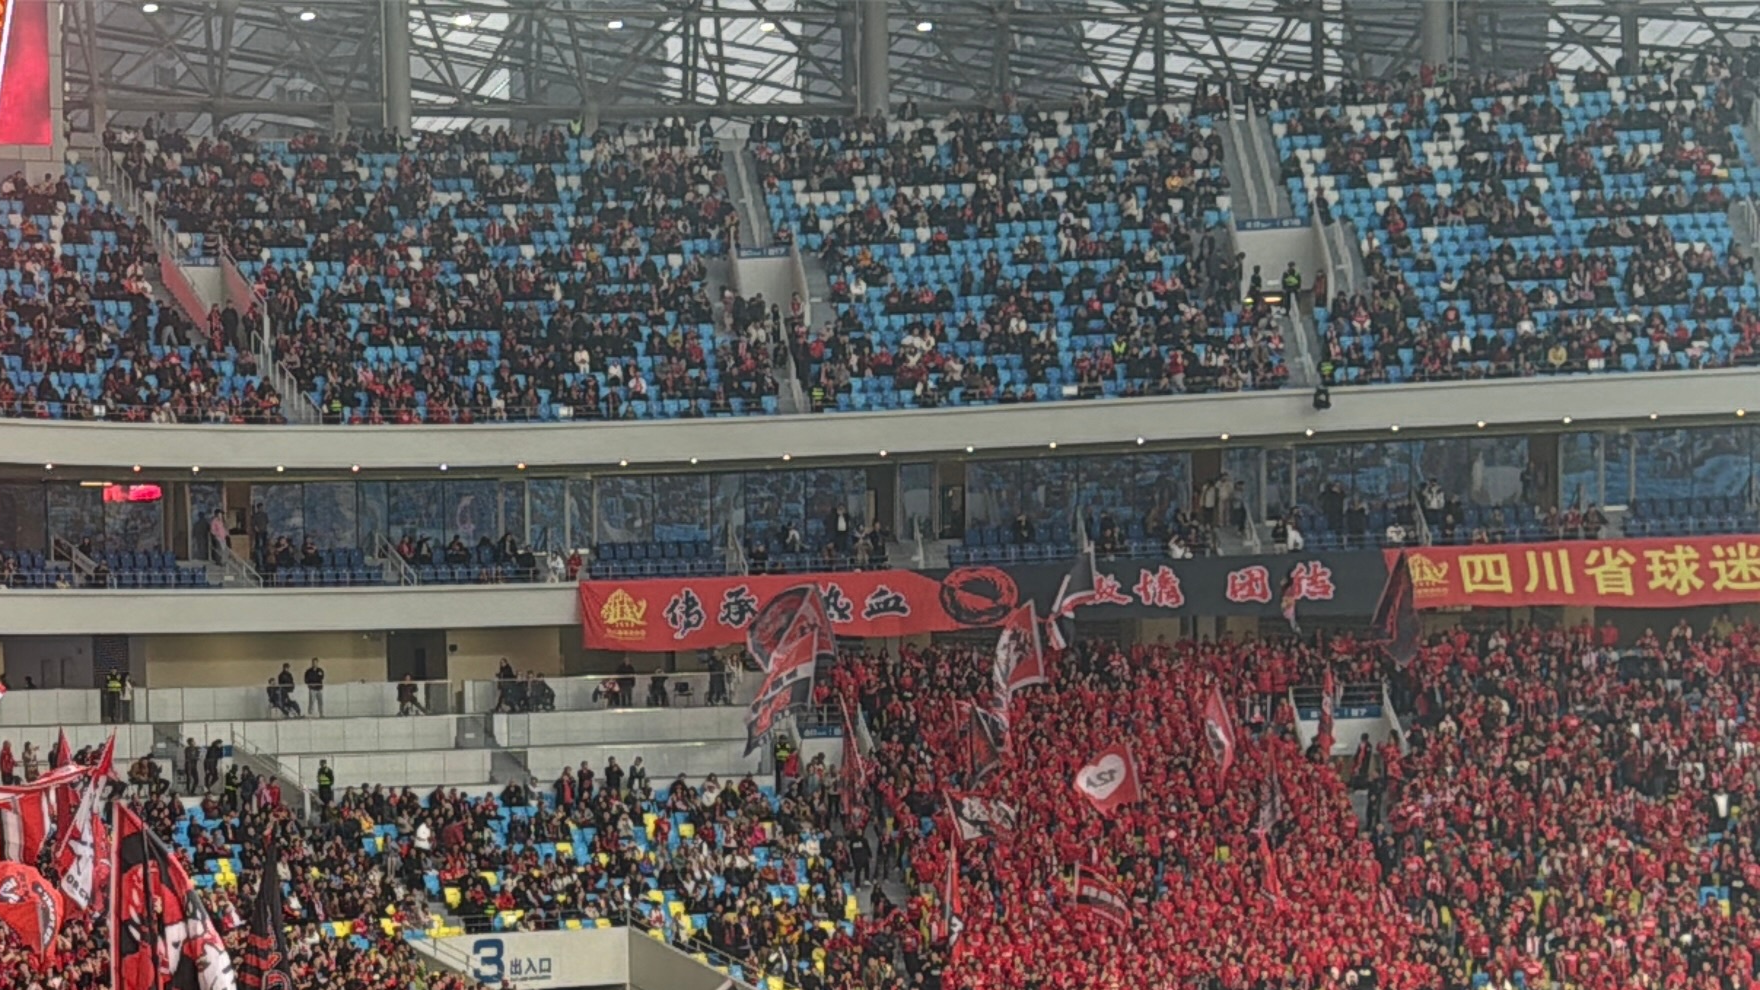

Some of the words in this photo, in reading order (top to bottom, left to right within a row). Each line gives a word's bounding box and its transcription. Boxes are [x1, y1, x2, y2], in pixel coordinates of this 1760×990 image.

[1458, 541, 1760, 597] 四川省球迷
[473, 939, 505, 983] 3
[510, 957, 552, 975] 出入口
